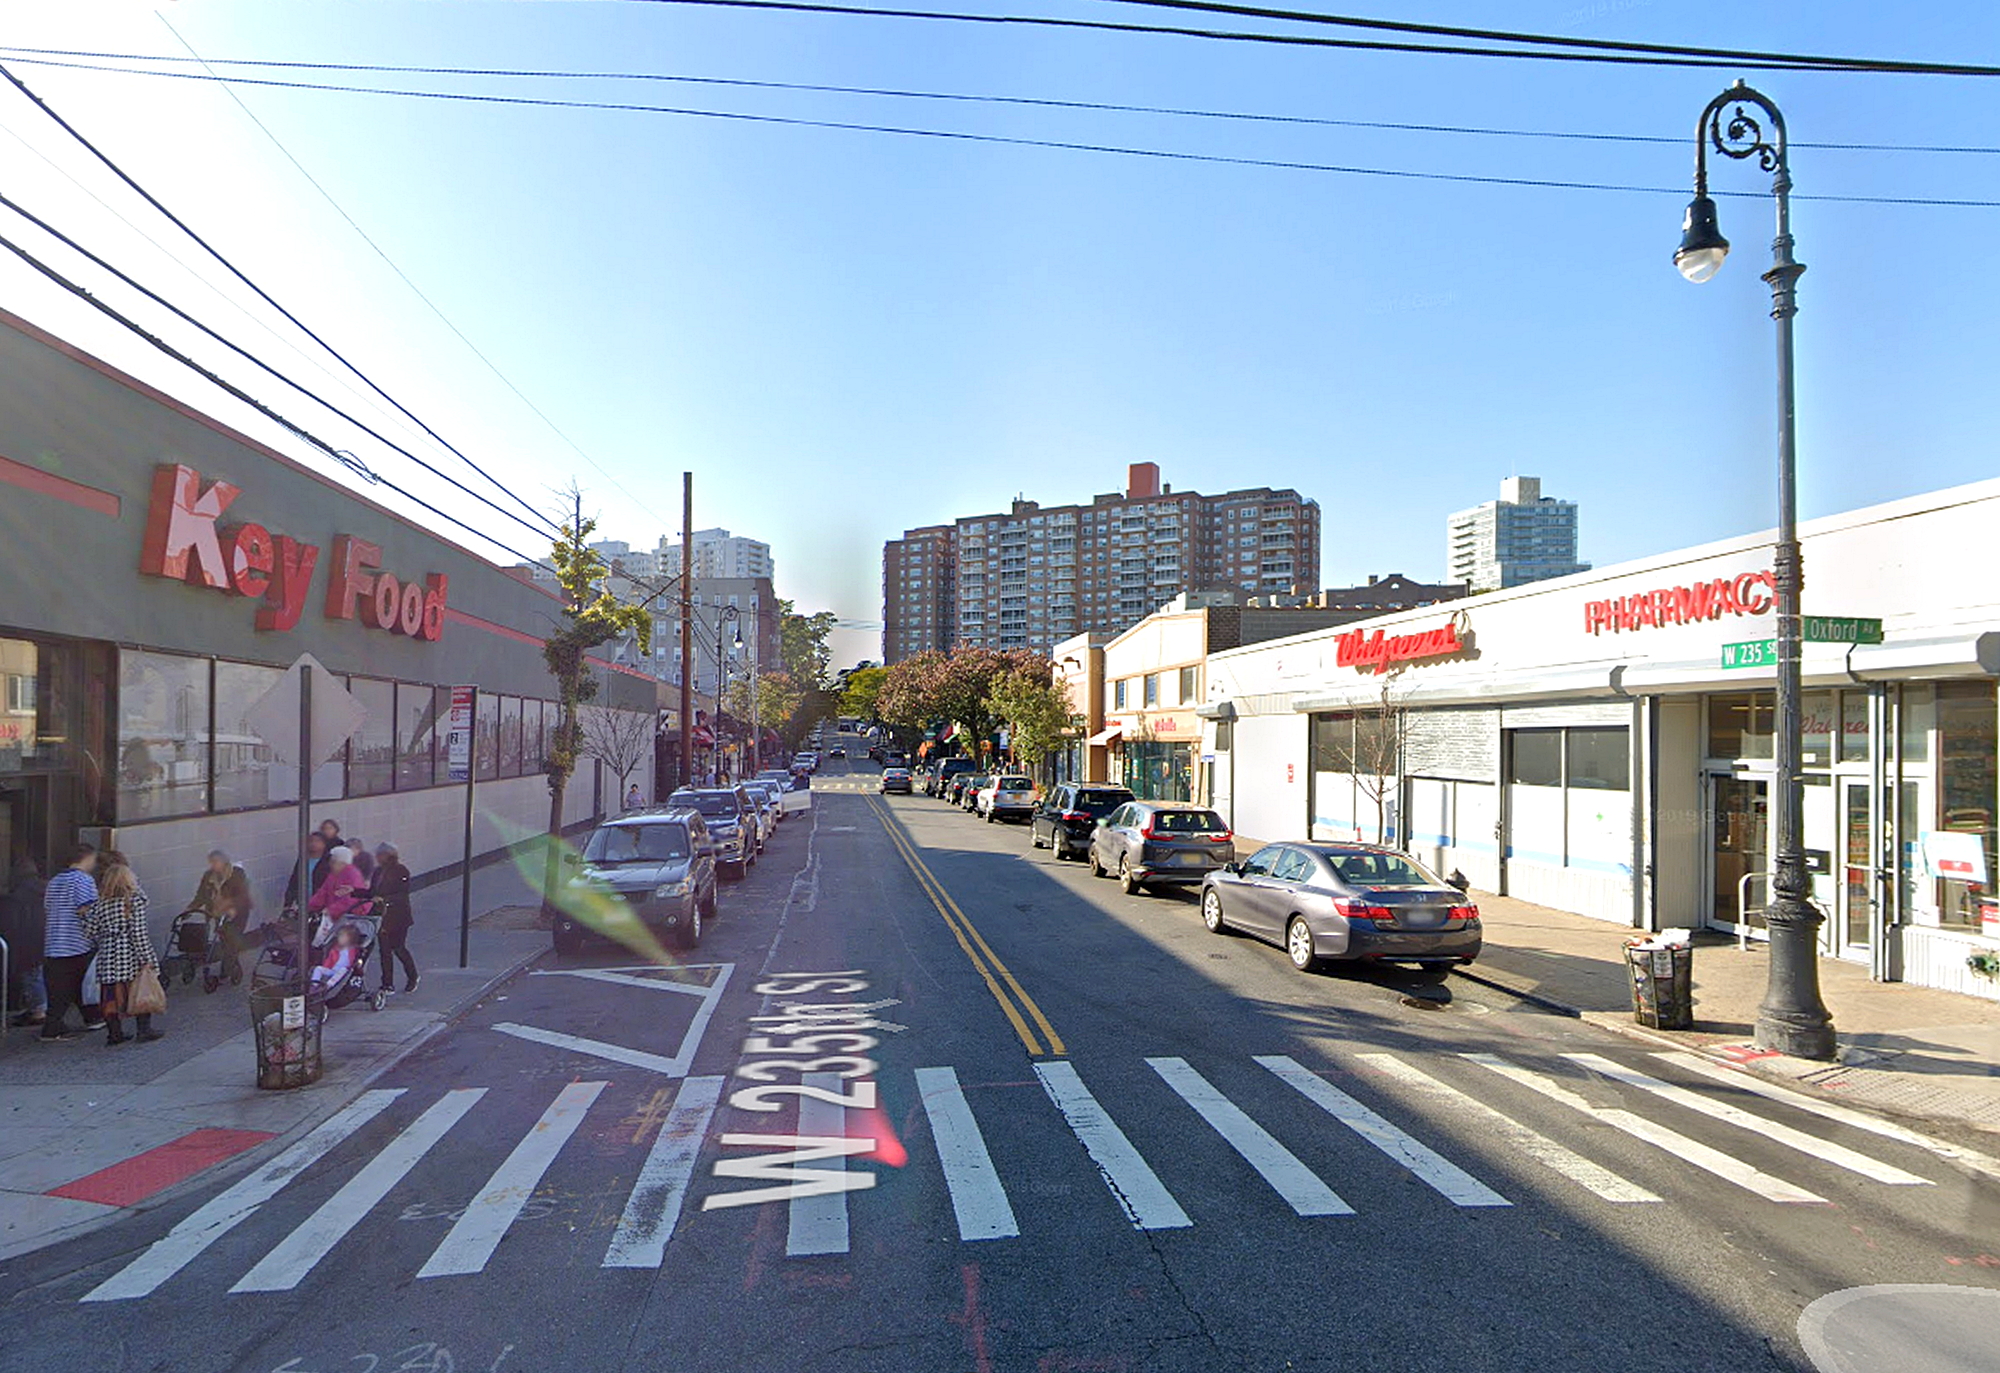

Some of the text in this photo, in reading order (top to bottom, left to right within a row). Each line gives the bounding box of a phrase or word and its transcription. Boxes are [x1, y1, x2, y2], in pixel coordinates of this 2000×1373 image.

[140, 464, 448, 640] Key Food
[1810, 619, 1857, 640] Oxford
[1334, 624, 1463, 676] Walgreens
[1724, 644, 1736, 665] W
[1740, 642, 1762, 664] 235
